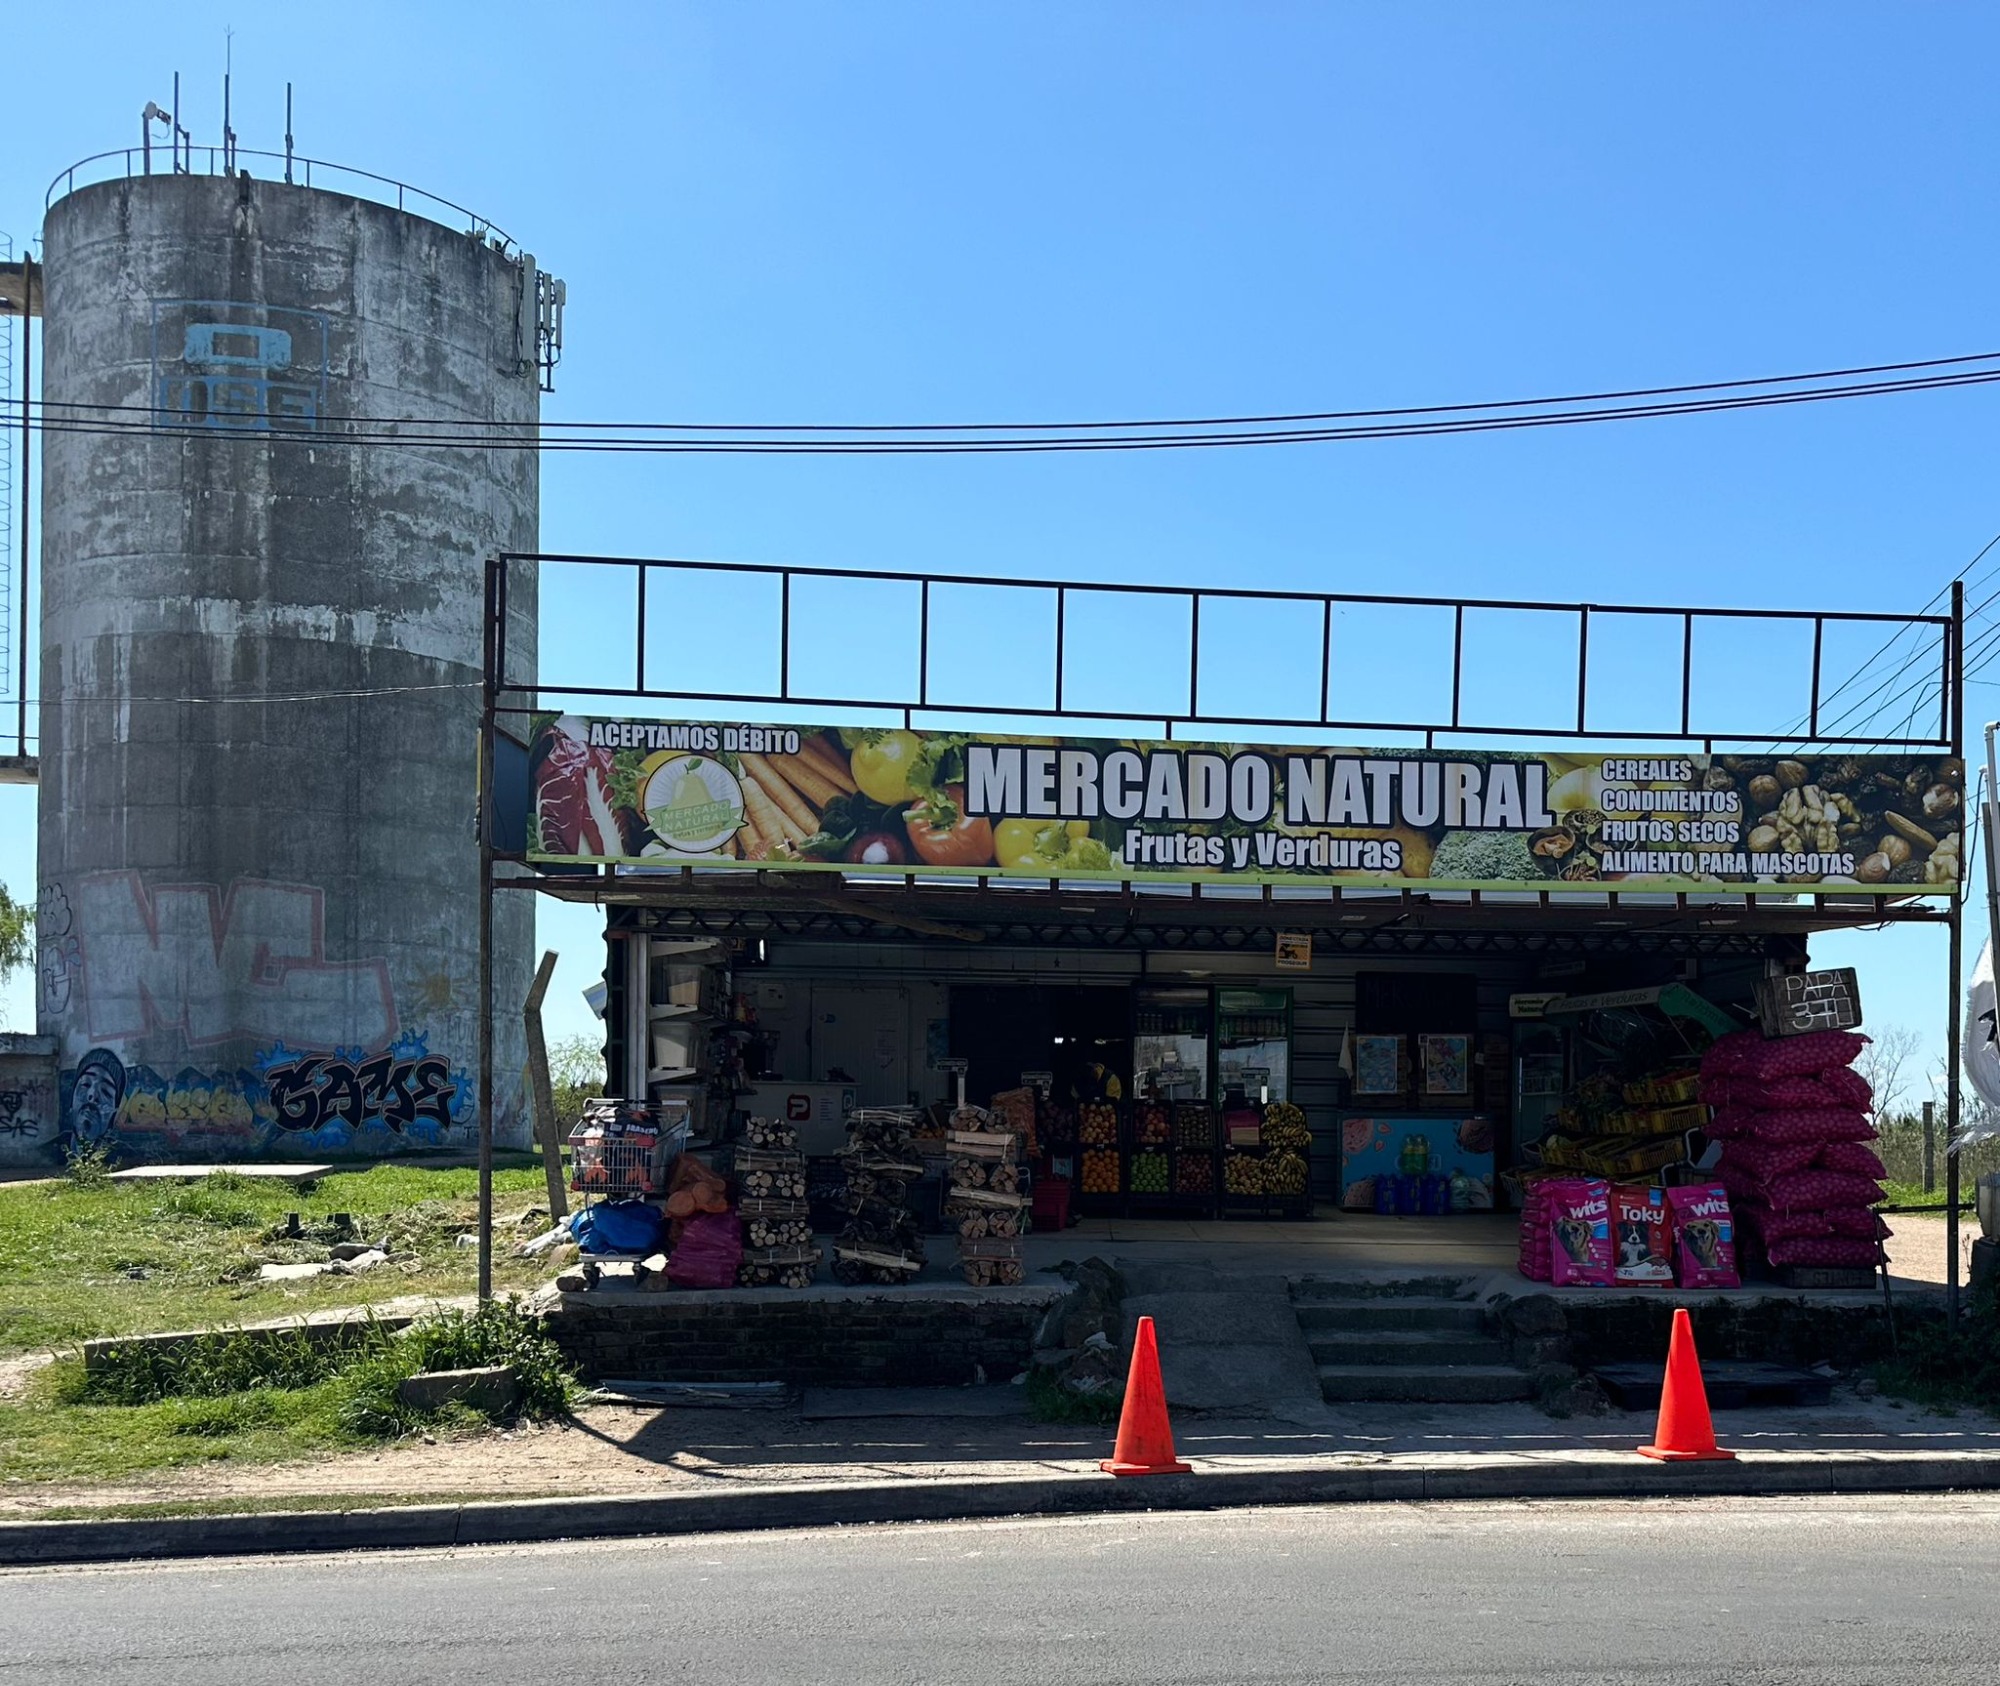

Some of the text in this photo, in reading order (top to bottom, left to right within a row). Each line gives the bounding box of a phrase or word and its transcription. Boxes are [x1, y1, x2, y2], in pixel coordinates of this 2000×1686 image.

[590, 723, 799, 754] ACEPTAMOS DÉBITO
[1602, 759, 1692, 781] CEREALES
[968, 747, 1551, 828] MERCADO NATURAL
[665, 803, 728, 820] MERCADO
[1602, 790, 1738, 812] CONDIMENTOS
[665, 813, 727, 831] NATURAL
[1602, 821, 1739, 843] FRUTOS SECOS
[1126, 828, 1400, 869] Frutas y Verduras
[1602, 851, 1854, 875] ALIMENTO PARA MASCOTAS
[1785, 971, 1848, 1001] PAPA
[1569, 1200, 1608, 1219] wits
[1619, 1205, 1665, 1225] Toky
[1690, 1197, 1730, 1217] wits
